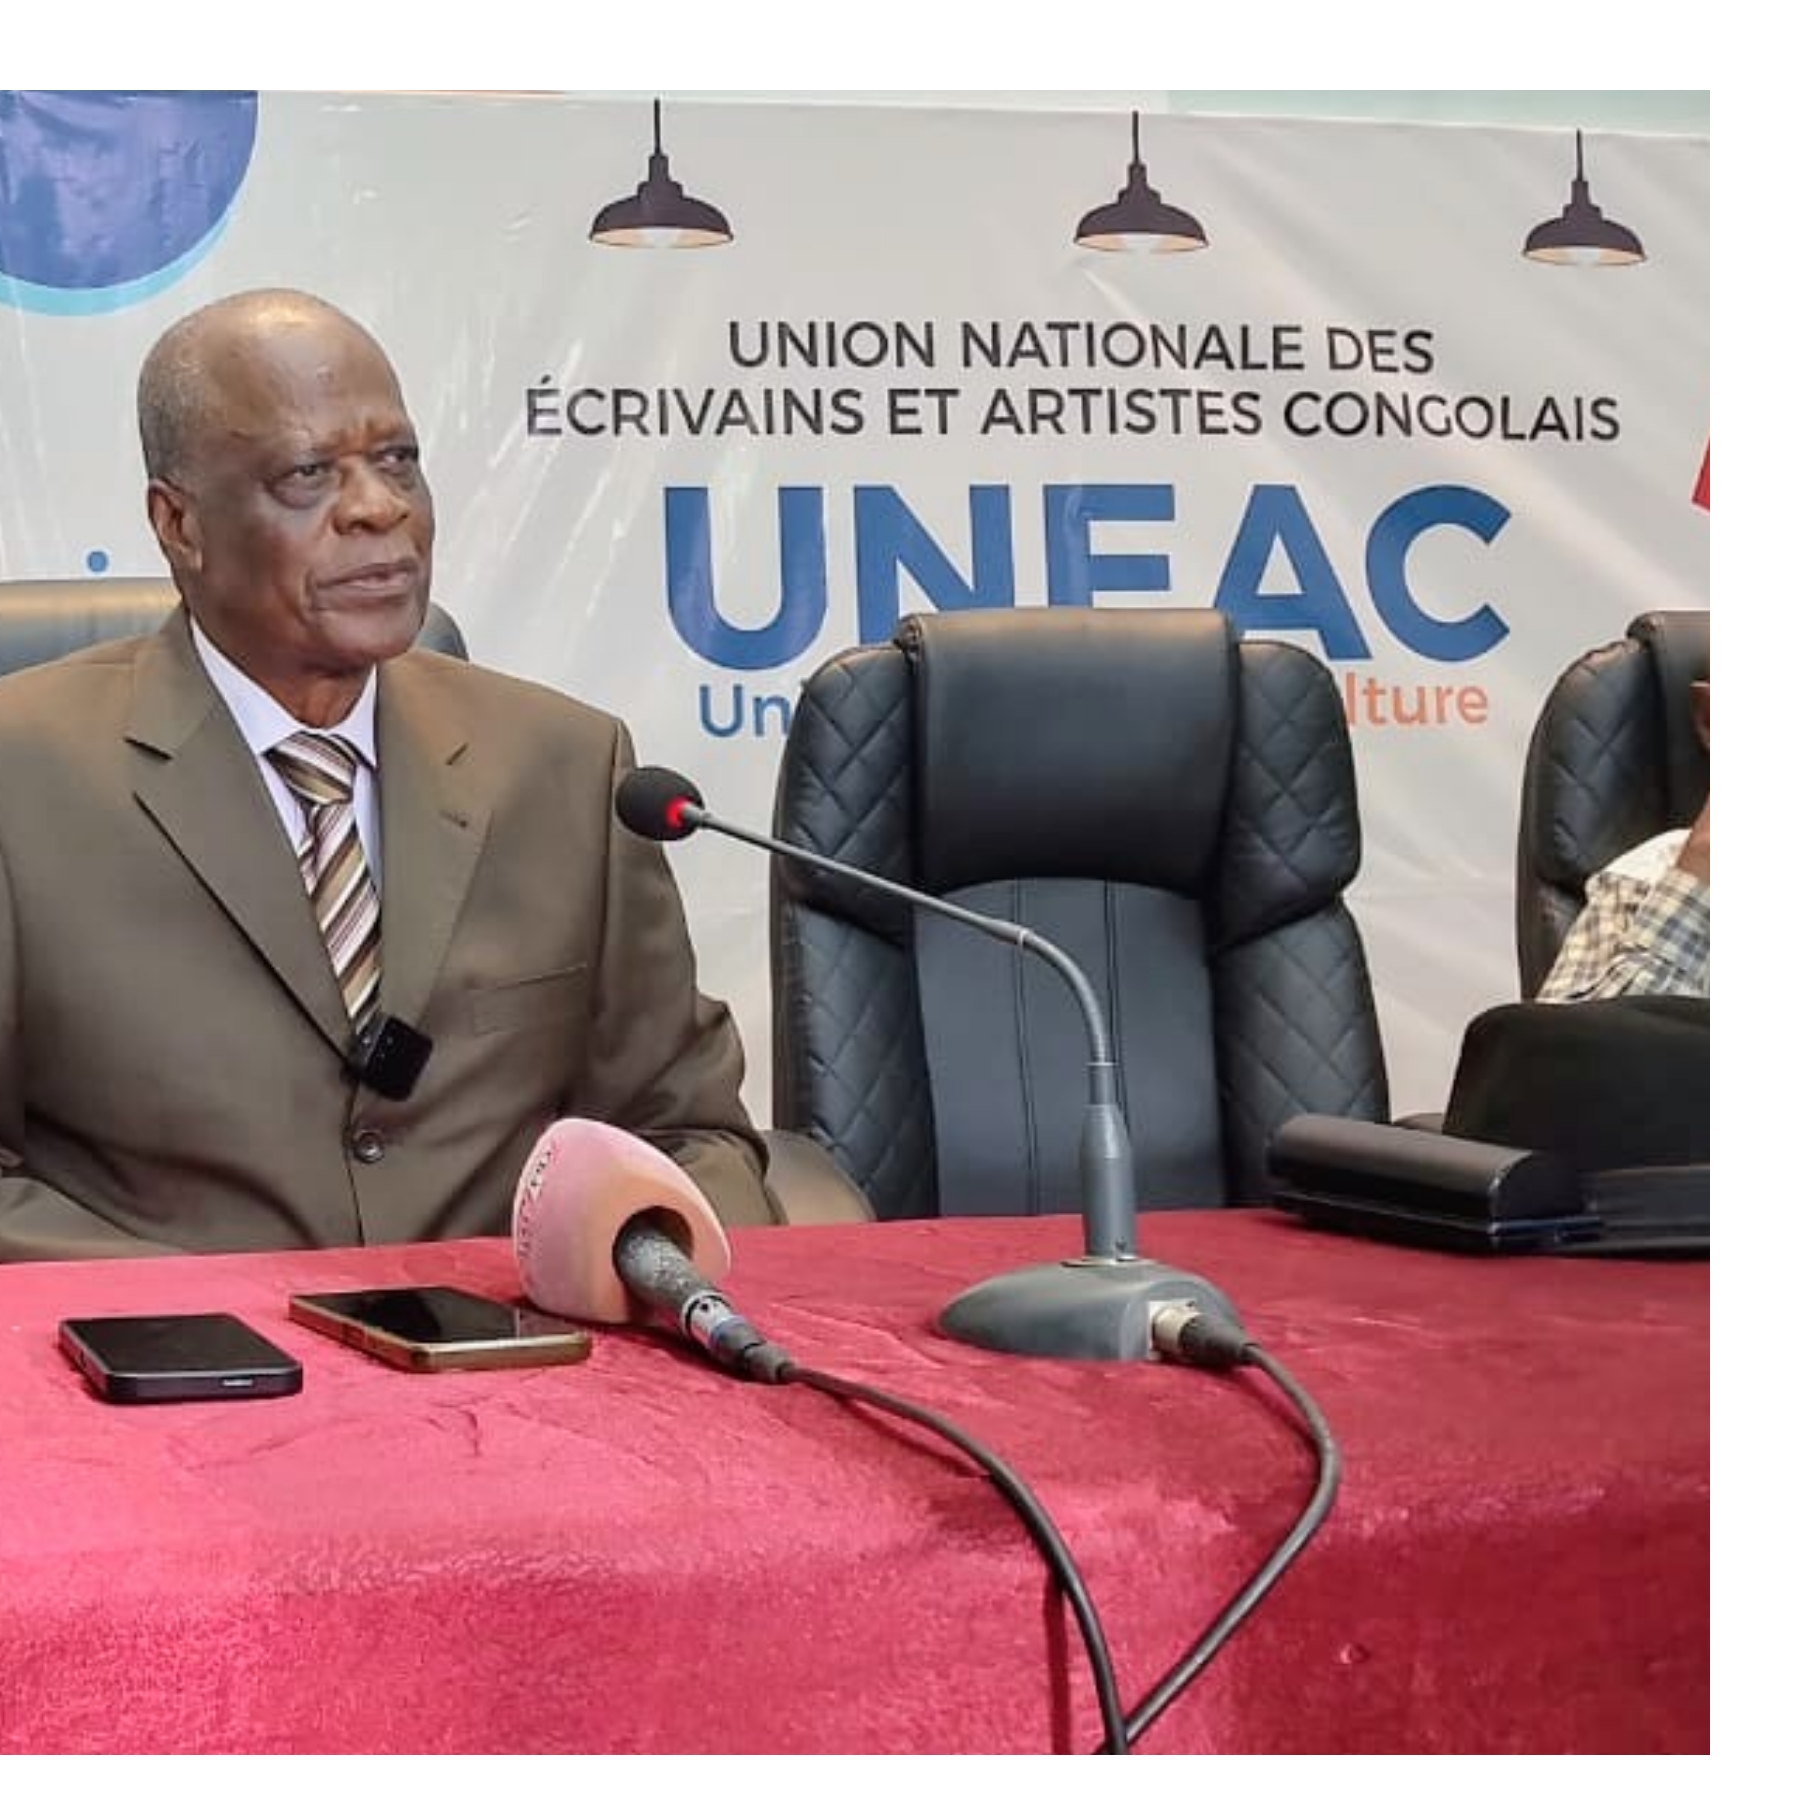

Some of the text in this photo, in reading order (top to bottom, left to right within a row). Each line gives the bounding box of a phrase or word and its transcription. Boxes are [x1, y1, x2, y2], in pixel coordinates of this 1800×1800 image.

[729, 321, 1435, 374] UNION NATIONALE DES
[526, 375, 1621, 441] ÉCRIVAINS ET ARTISTES CONGOLAIS
